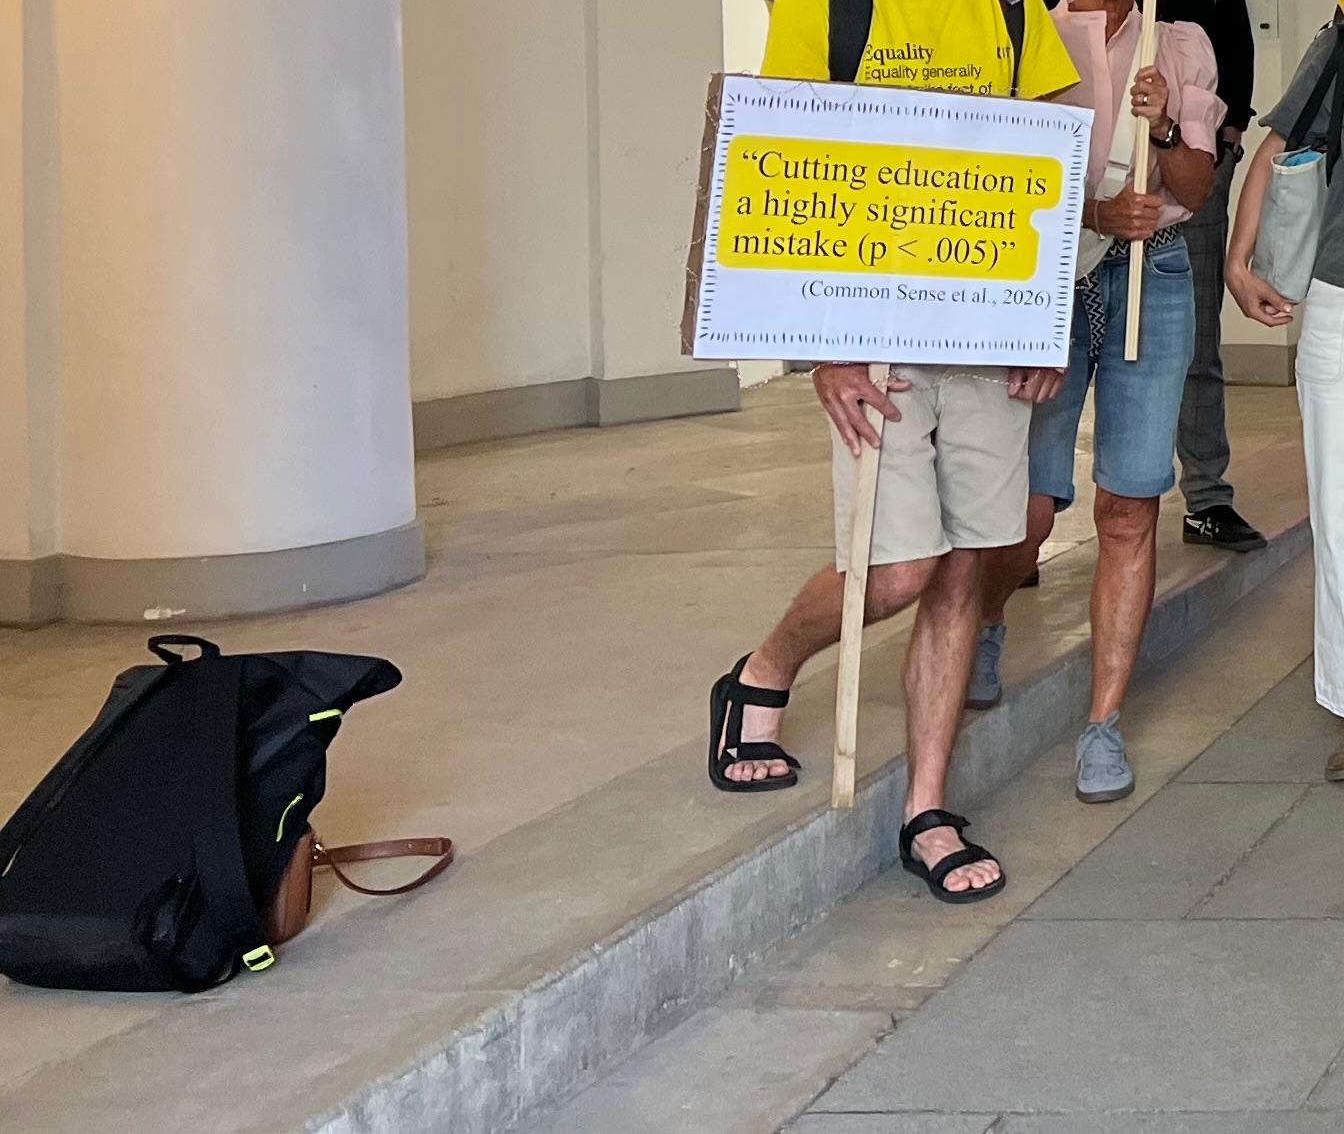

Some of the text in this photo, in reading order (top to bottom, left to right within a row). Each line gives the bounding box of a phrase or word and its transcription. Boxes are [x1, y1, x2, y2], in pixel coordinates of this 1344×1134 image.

[922, 63, 983, 81] generally
[877, 160, 1015, 194] education
[1025, 168, 1047, 196] is
[736, 189, 1016, 231] a highly significant
[732, 227, 848, 259] mistake
[858, 232, 887, 268] (p
[896, 238, 919, 259] <
[801, 279, 1053, 310] (Common Sense et al., 2026)
